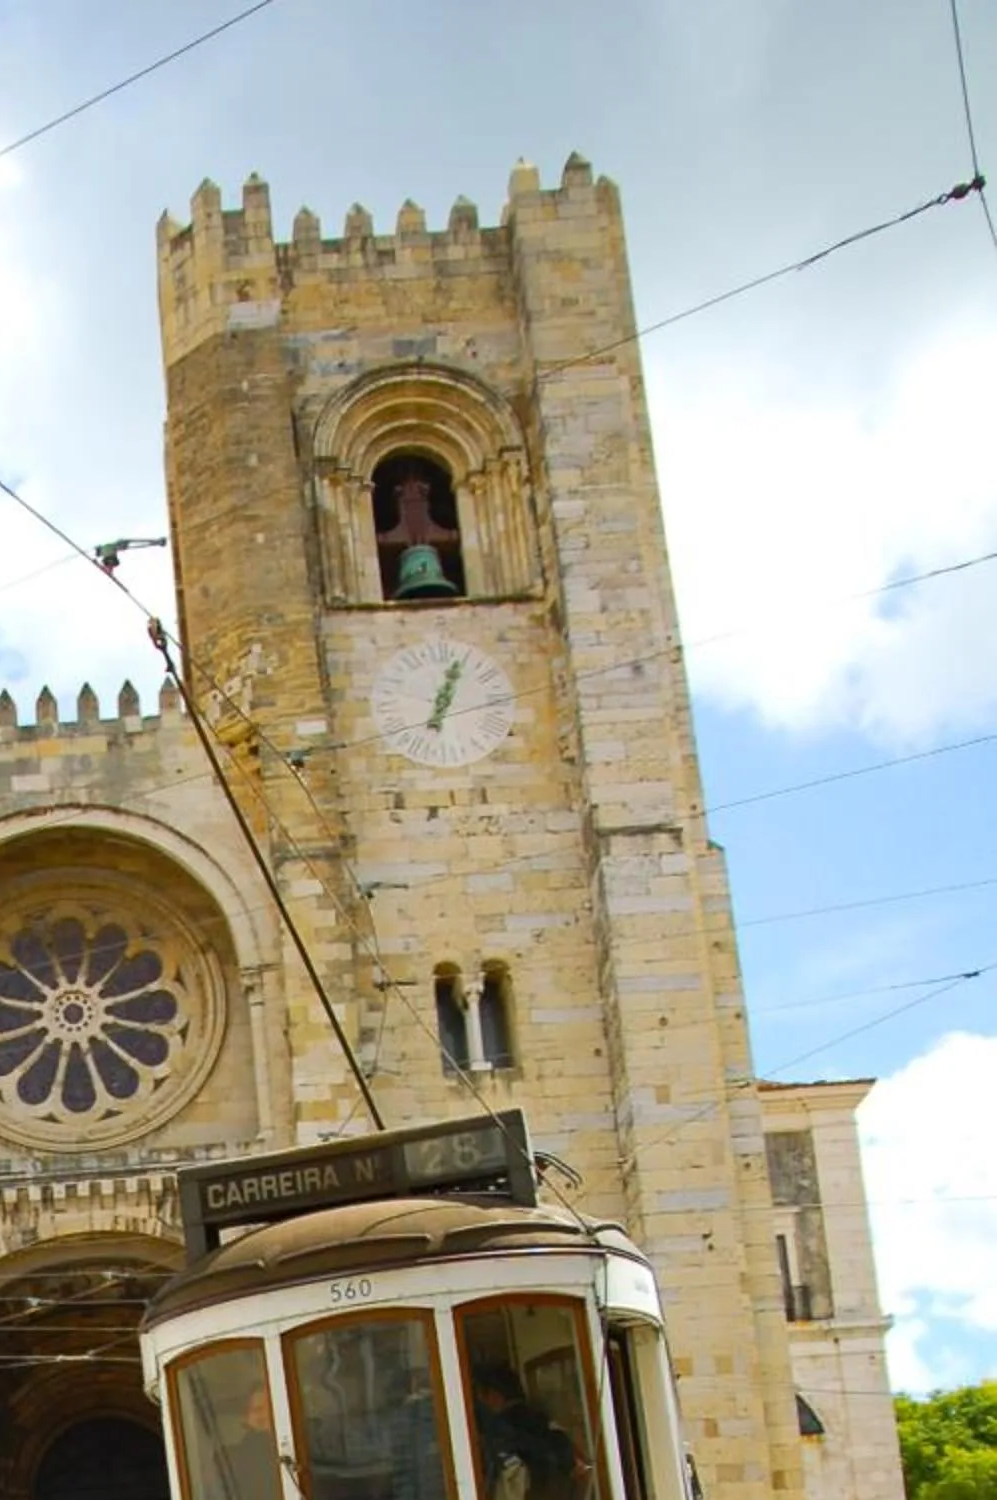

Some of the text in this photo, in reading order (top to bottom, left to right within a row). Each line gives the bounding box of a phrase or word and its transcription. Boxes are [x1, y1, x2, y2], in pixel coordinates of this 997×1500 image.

[207, 1165, 340, 1209] CARREIRA
[420, 1133, 480, 1177] 28
[330, 1279, 372, 1303] 560
